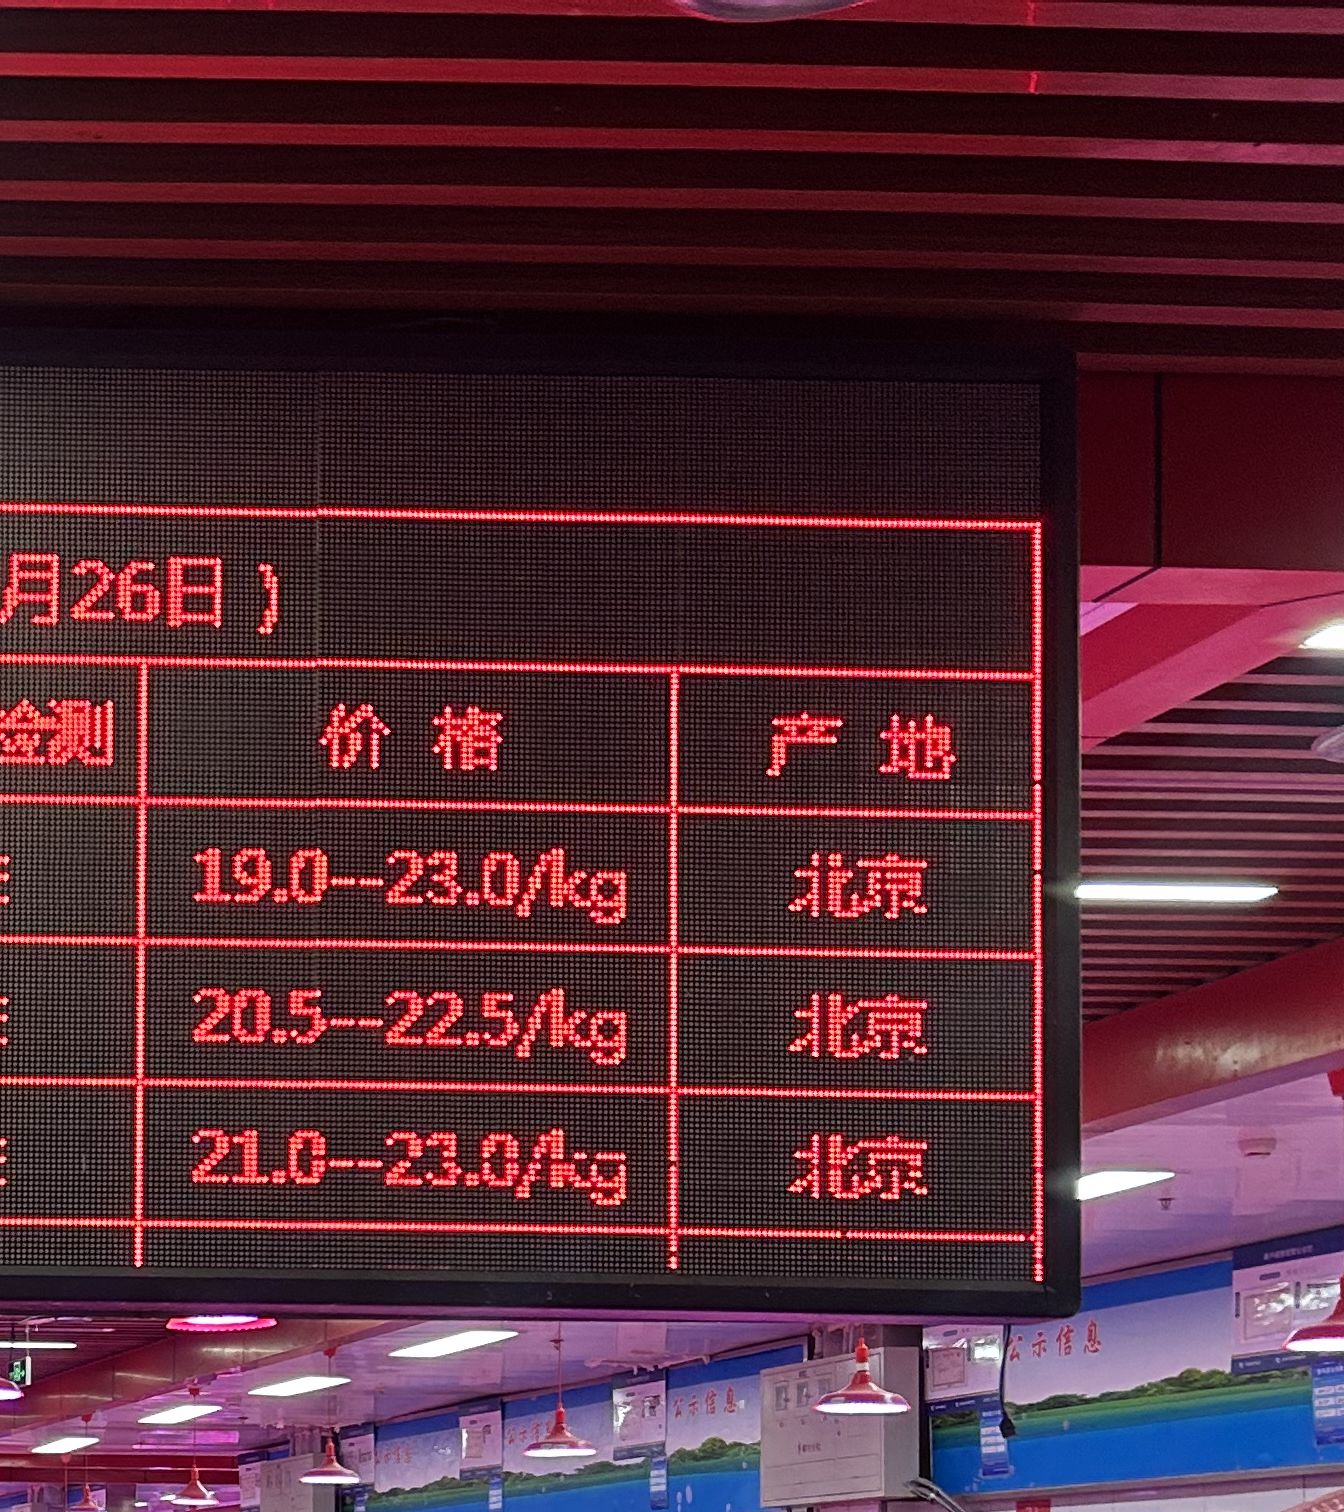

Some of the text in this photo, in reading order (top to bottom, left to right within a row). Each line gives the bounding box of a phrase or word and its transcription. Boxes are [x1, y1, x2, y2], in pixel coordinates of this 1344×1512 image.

[788, 852, 929, 918] 北京
[786, 992, 927, 1059] 北京
[787, 1134, 928, 1200] 北京
[1007, 1321, 1101, 1361] 公示信息
